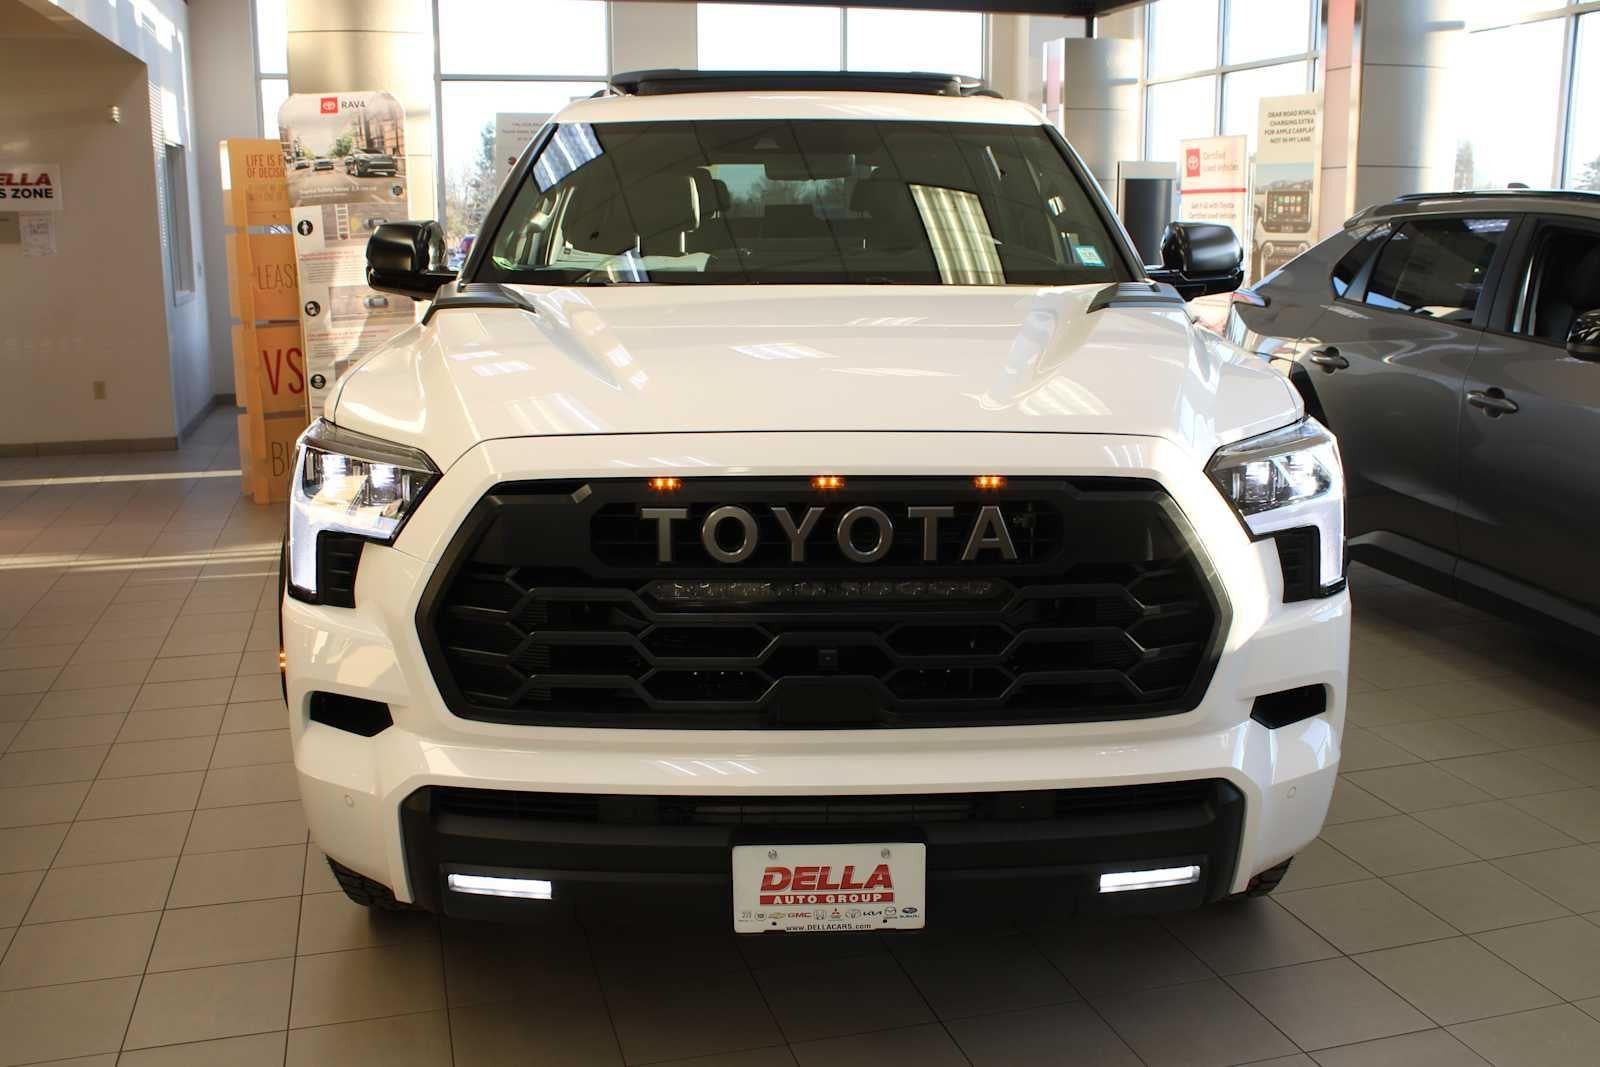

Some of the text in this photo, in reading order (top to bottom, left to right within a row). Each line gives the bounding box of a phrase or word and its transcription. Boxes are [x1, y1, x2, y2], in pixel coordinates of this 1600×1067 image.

[341, 101, 366, 109] RAV4
[1264, 128, 1275, 136] FOR
[246, 153, 264, 167] LIFE
[267, 153, 275, 166] IS
[248, 167, 256, 178] OF
[11, 188, 53, 199] ZONE
[262, 347, 305, 396] VS
[640, 505, 1019, 563] TOYOTA
[760, 864, 893, 891] DELLA
[773, 893, 882, 904] AUTO GROUP
